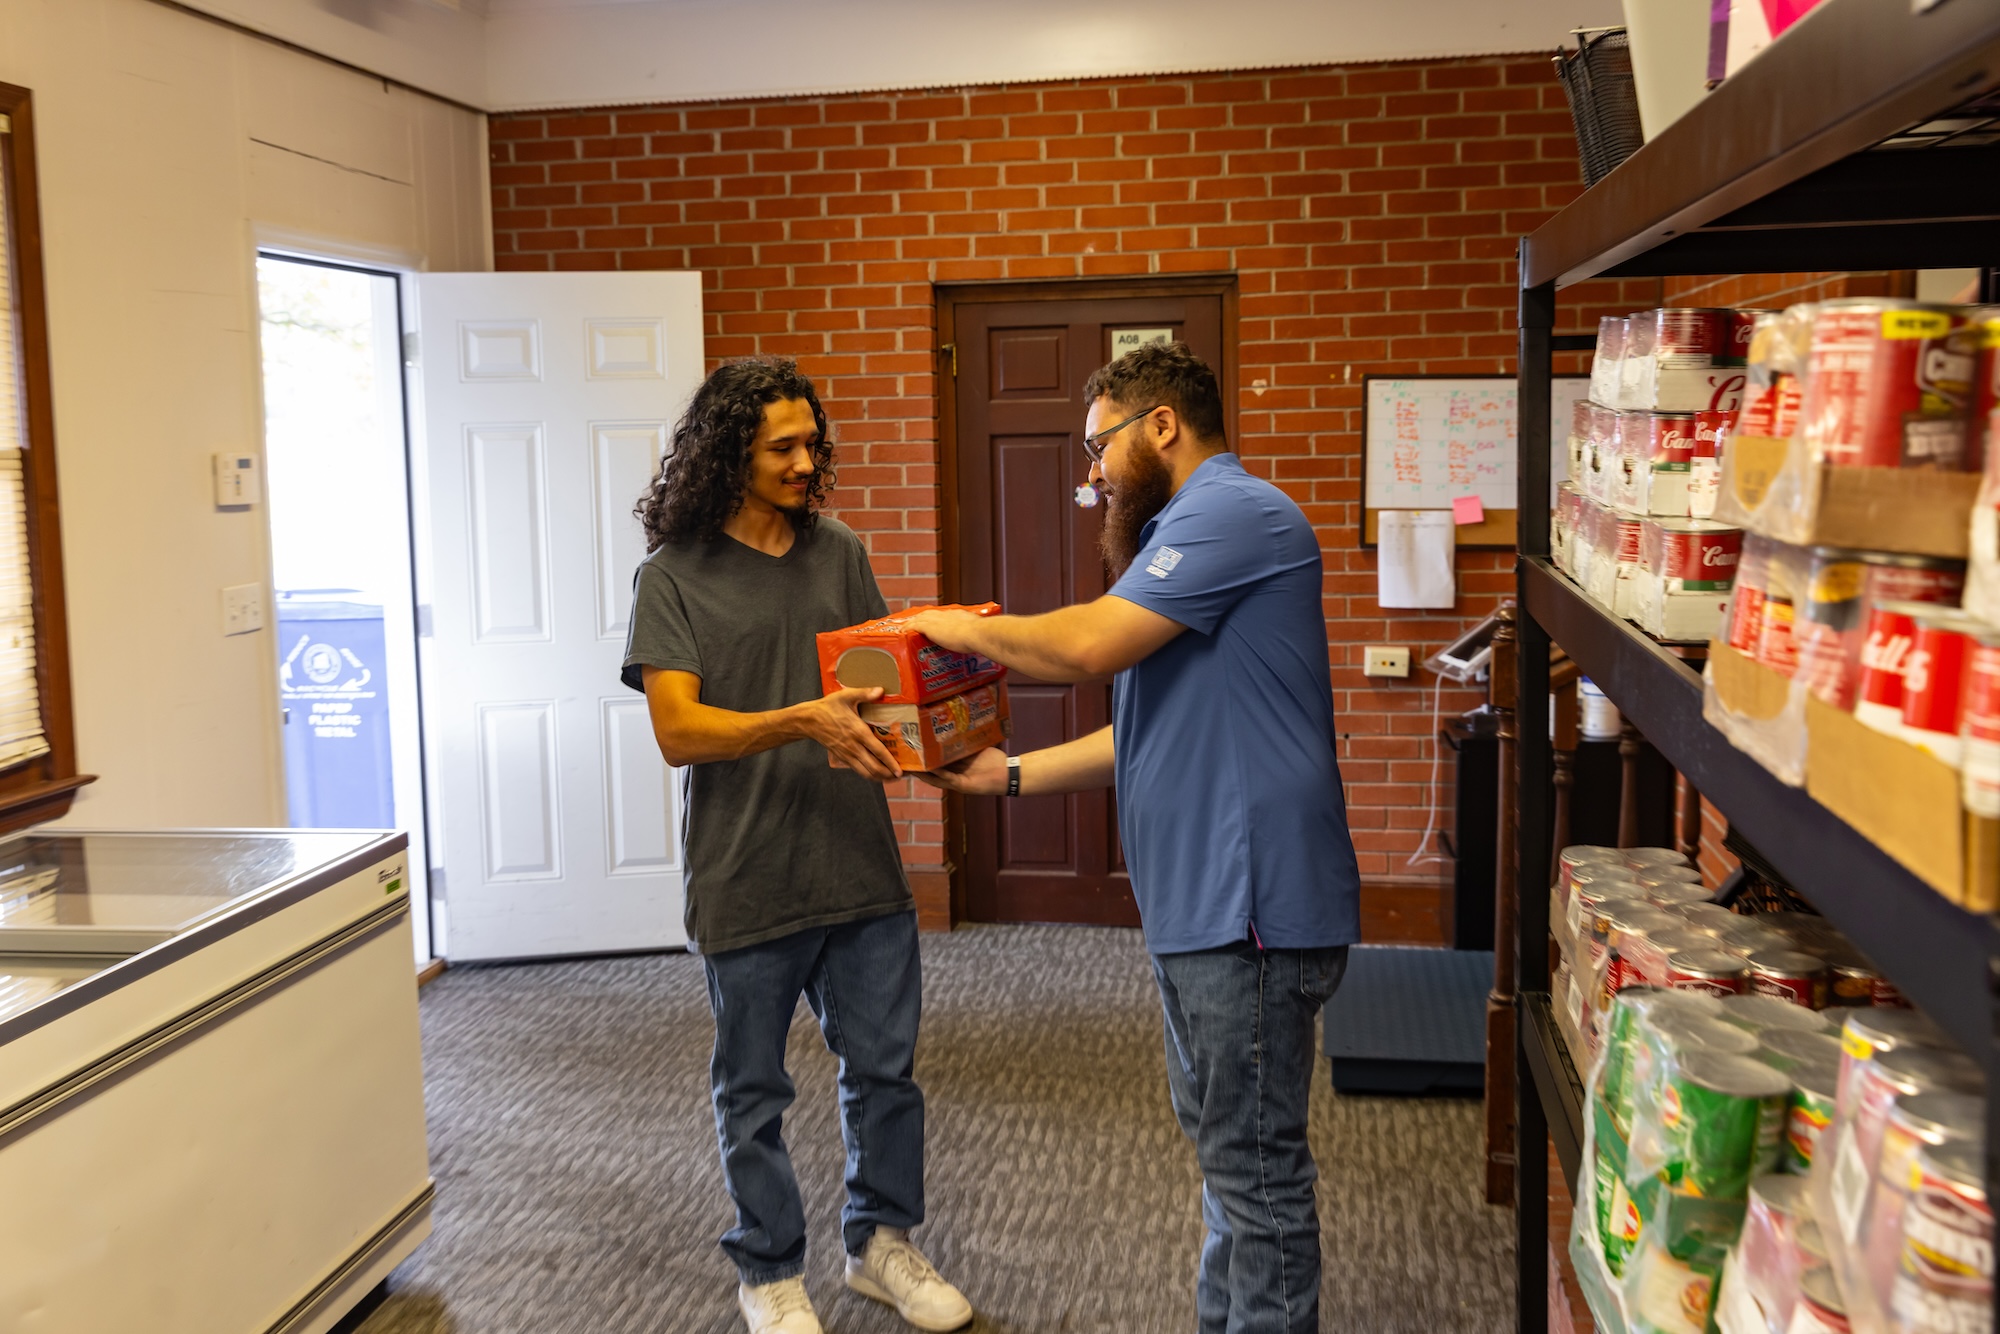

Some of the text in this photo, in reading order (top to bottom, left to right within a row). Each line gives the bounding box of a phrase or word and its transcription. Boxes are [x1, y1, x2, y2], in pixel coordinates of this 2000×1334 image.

[1119, 334, 1139, 344] A08
[965, 656, 980, 675] 12
[308, 714, 362, 726] PLASTIC
